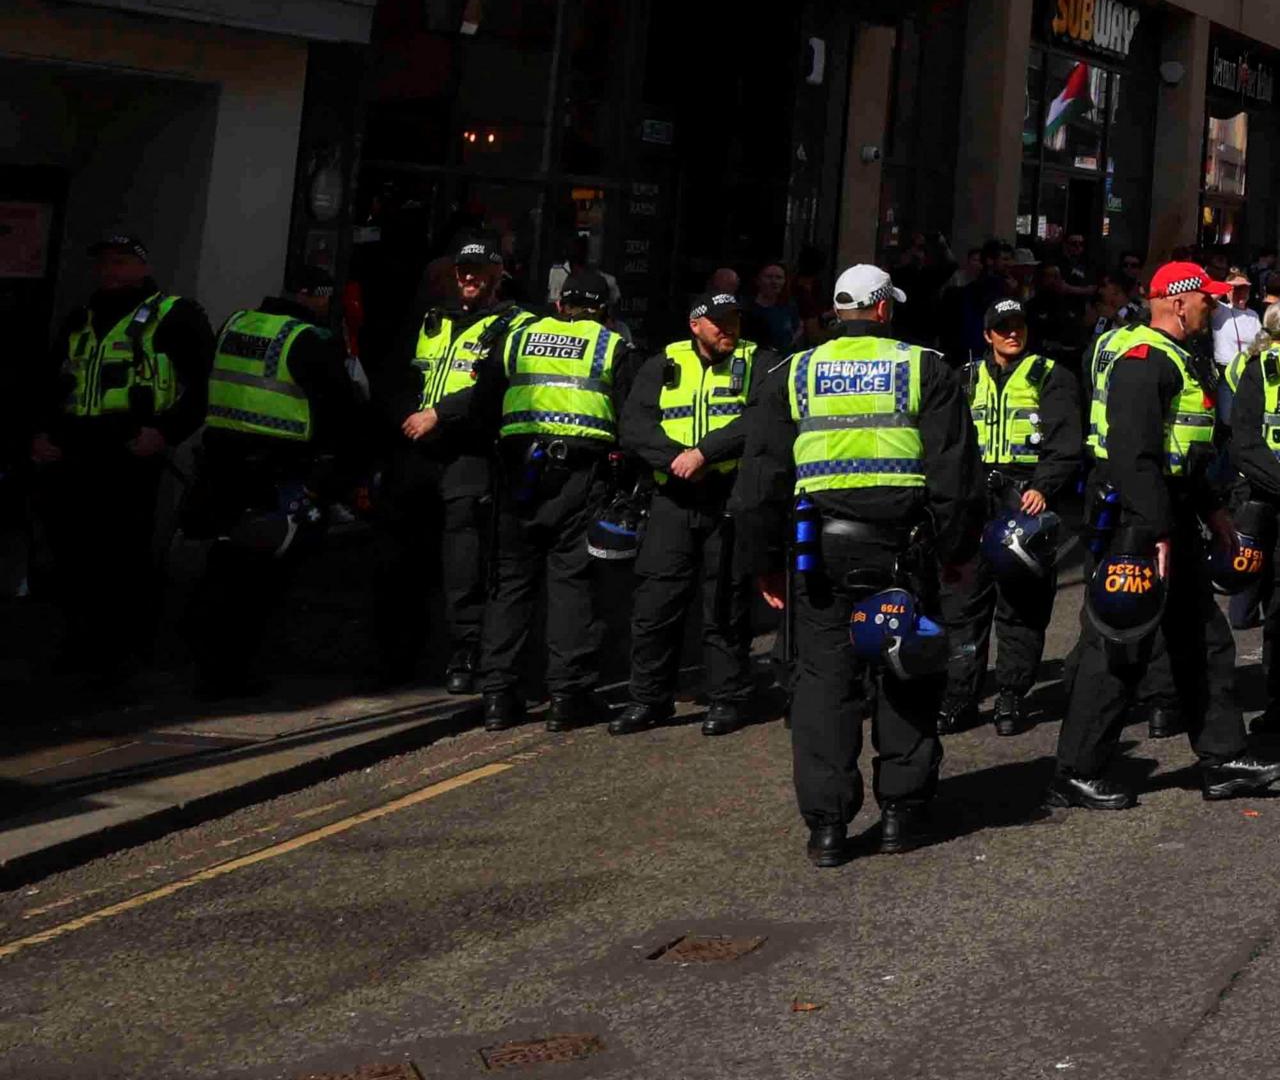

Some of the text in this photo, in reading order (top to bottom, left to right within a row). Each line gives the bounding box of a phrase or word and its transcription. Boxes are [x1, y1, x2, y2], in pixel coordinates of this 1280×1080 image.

[529, 333, 585, 348] HEDDLU
[525, 345, 582, 359] POLICE
[820, 376, 886, 393] POLICE
[1107, 564, 1141, 577] 1234
[1232, 555, 1263, 574] WO
[1105, 574, 1144, 594] WO
